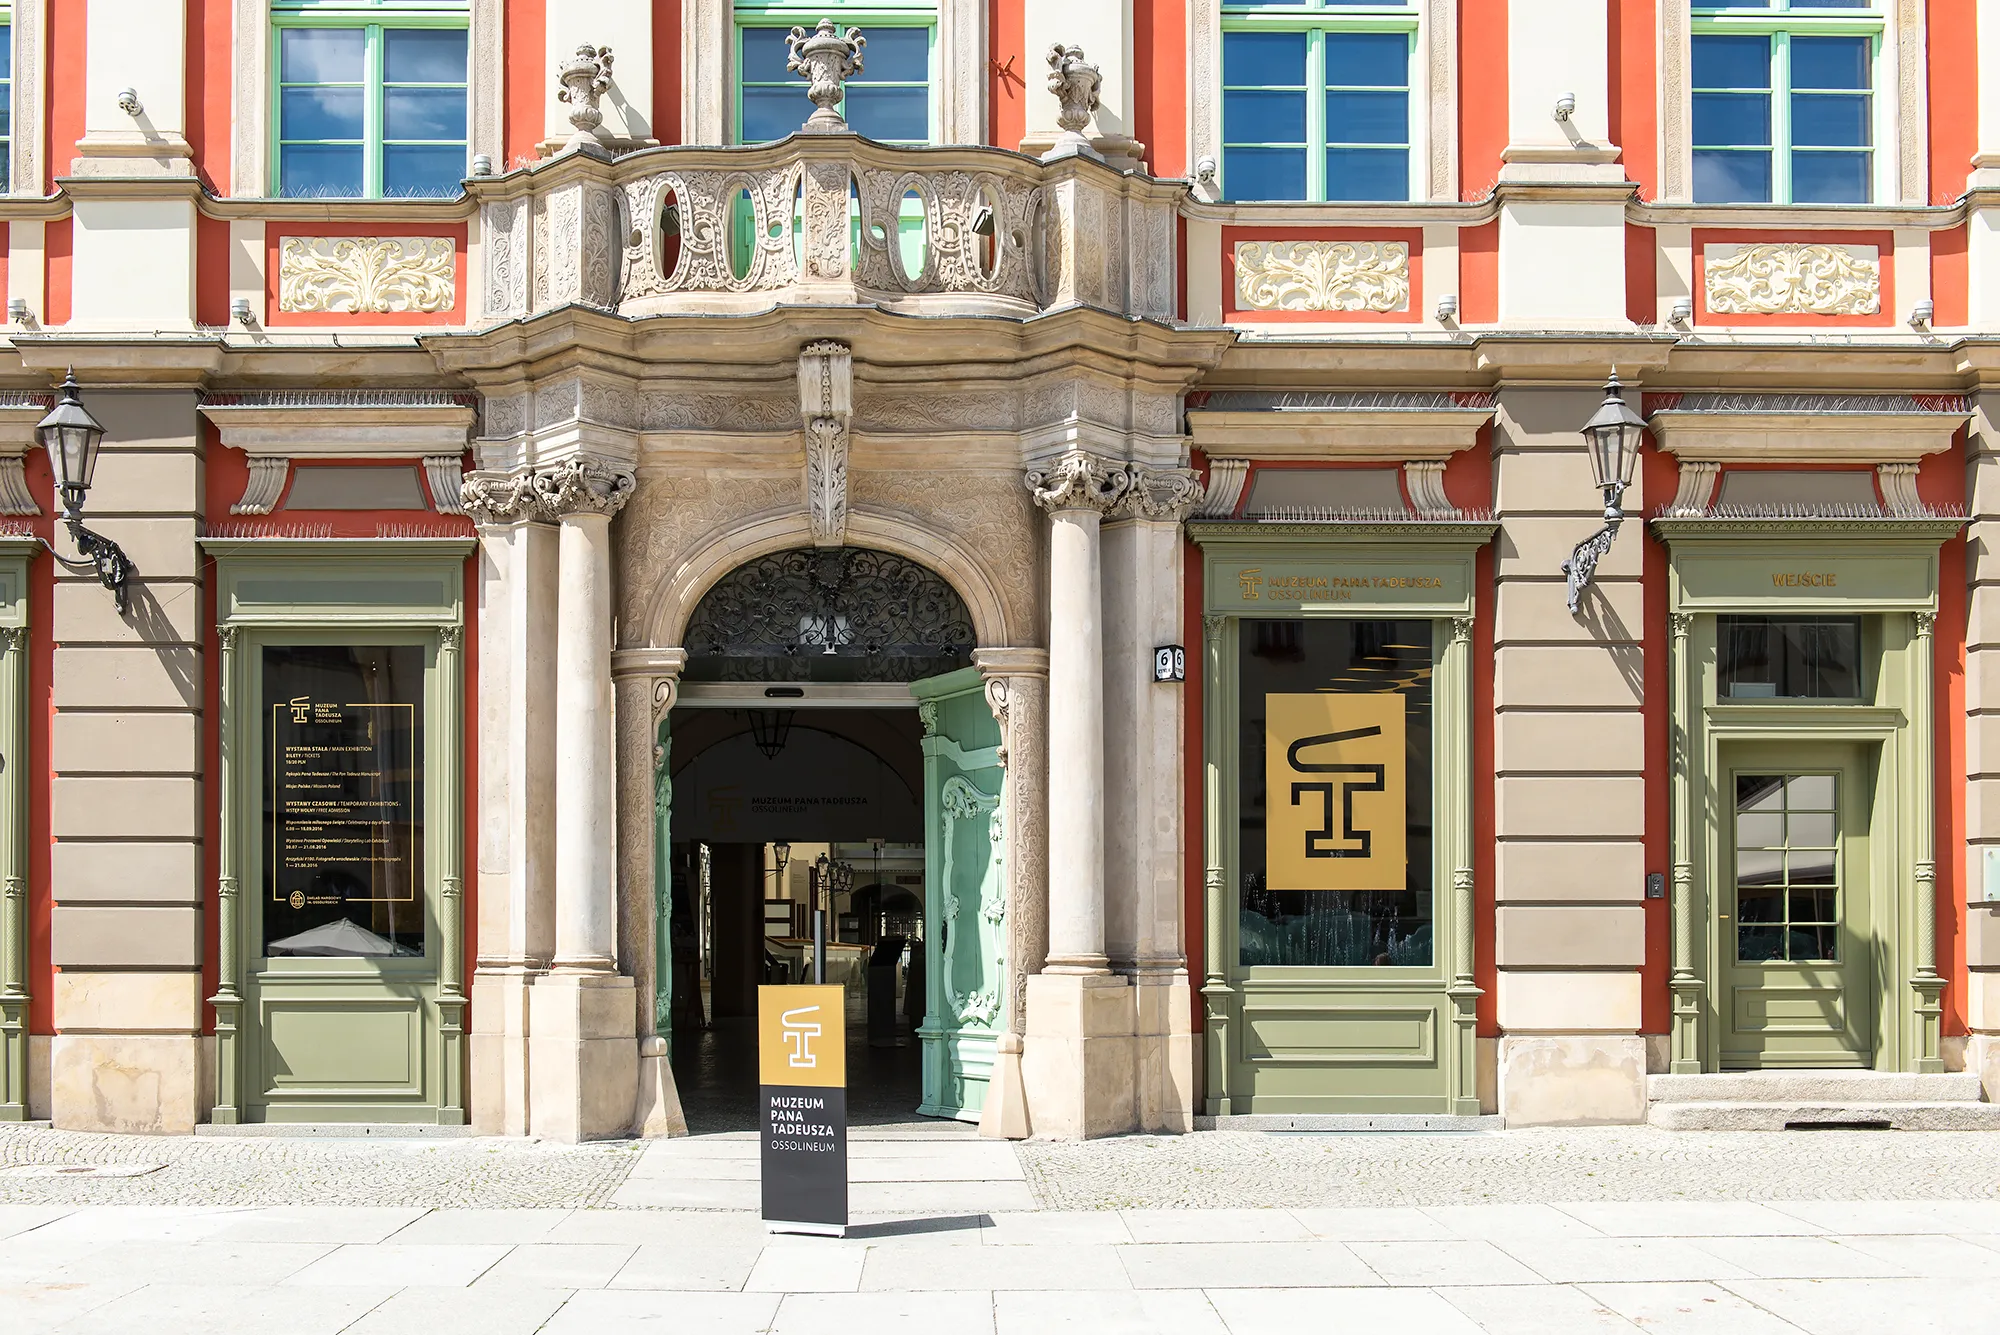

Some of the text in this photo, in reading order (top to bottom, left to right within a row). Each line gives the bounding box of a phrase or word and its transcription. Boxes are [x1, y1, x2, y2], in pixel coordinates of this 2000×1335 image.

[1268, 576, 1442, 588] MUZEUM PANA TADEUSZA
[1772, 571, 1836, 587] WEJŚCIE
[1268, 590, 1351, 600] OSSOLINEUM
[1161, 652, 1168, 666] 6
[1177, 652, 1182, 665] 6
[752, 797, 868, 805] MUZEUM PANA TADEUSZA
[771, 1096, 824, 1109] MUZEUM
[771, 1110, 804, 1122] PANA
[771, 1123, 834, 1137] TADEUSZA
[771, 1140, 835, 1152] OSSOLINEUM
